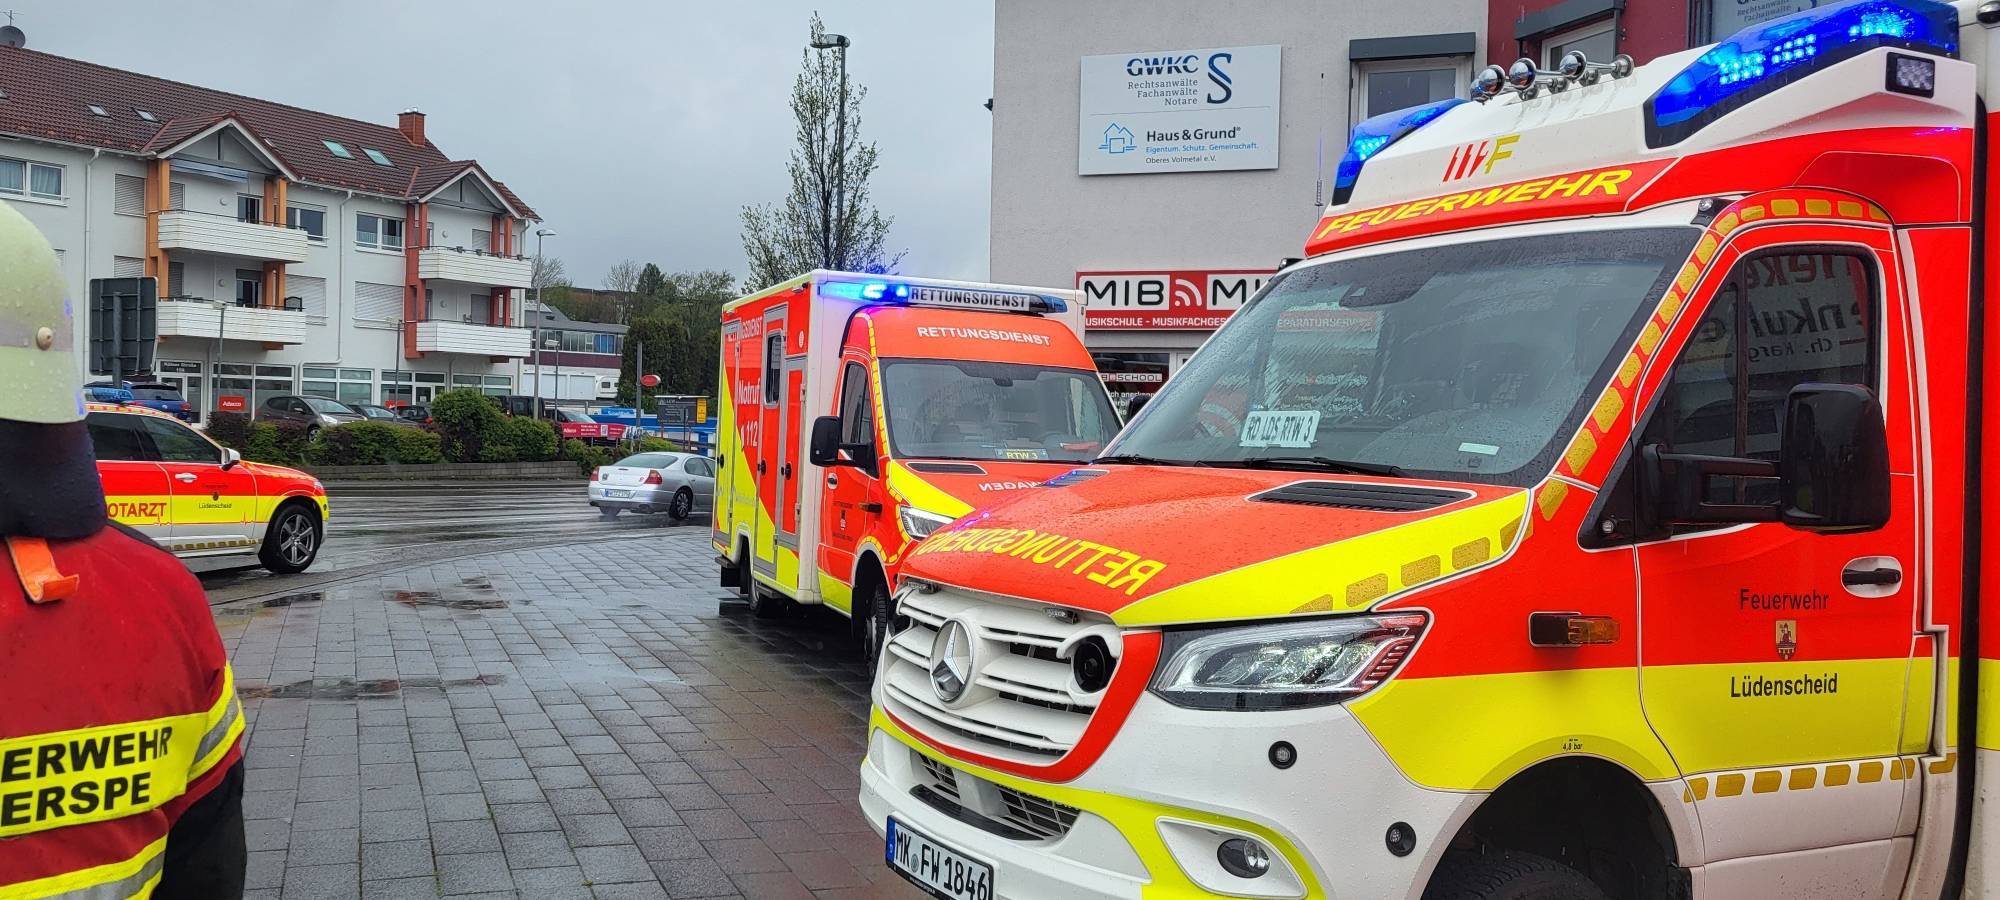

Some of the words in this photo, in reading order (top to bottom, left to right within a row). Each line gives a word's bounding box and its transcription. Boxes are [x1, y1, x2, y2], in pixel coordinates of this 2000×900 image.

[1126, 55, 1199, 76] GWKC
[1128, 78, 1198, 90] Rechtsanwälte
[1137, 87, 1198, 98] Fachanwälte
[1164, 97, 1198, 106] Notare
[1147, 130, 1180, 142] Haus
[1182, 129, 1192, 140] &
[1146, 146, 1180, 154] Eigentum.
[1182, 144, 1206, 152] Schutz.
[1209, 142, 1259, 151] Gemeinschaft.
[1317, 168, 1632, 240] FEUERWEHR
[911, 287, 1027, 308] RETTUNGSDIENST
[1084, 279, 1164, 306] MIB
[1085, 317, 1143, 327] USIKSCHULE
[1152, 317, 1228, 327] MUSIKFACHGES
[917, 326, 1051, 346] RETTUNGSDIENST
[1117, 374, 1162, 382] SCHOOL
[738, 377, 761, 406] Notruf
[746, 419, 758, 447] 112
[1281, 416, 1306, 441] RTW
[1304, 416, 1314, 442] 3
[1006, 451, 1030, 460] RTW
[107, 502, 167, 518] OTARZT
[1739, 588, 1829, 611] Feuerwehr
[1730, 673, 1839, 698] Lüdenscheid
[0, 726, 173, 784] ERWEHR
[0, 771, 152, 828] ERSPE
[895, 828, 912, 868] MK
[920, 843, 941, 884] FW
[943, 856, 988, 900] 1846
